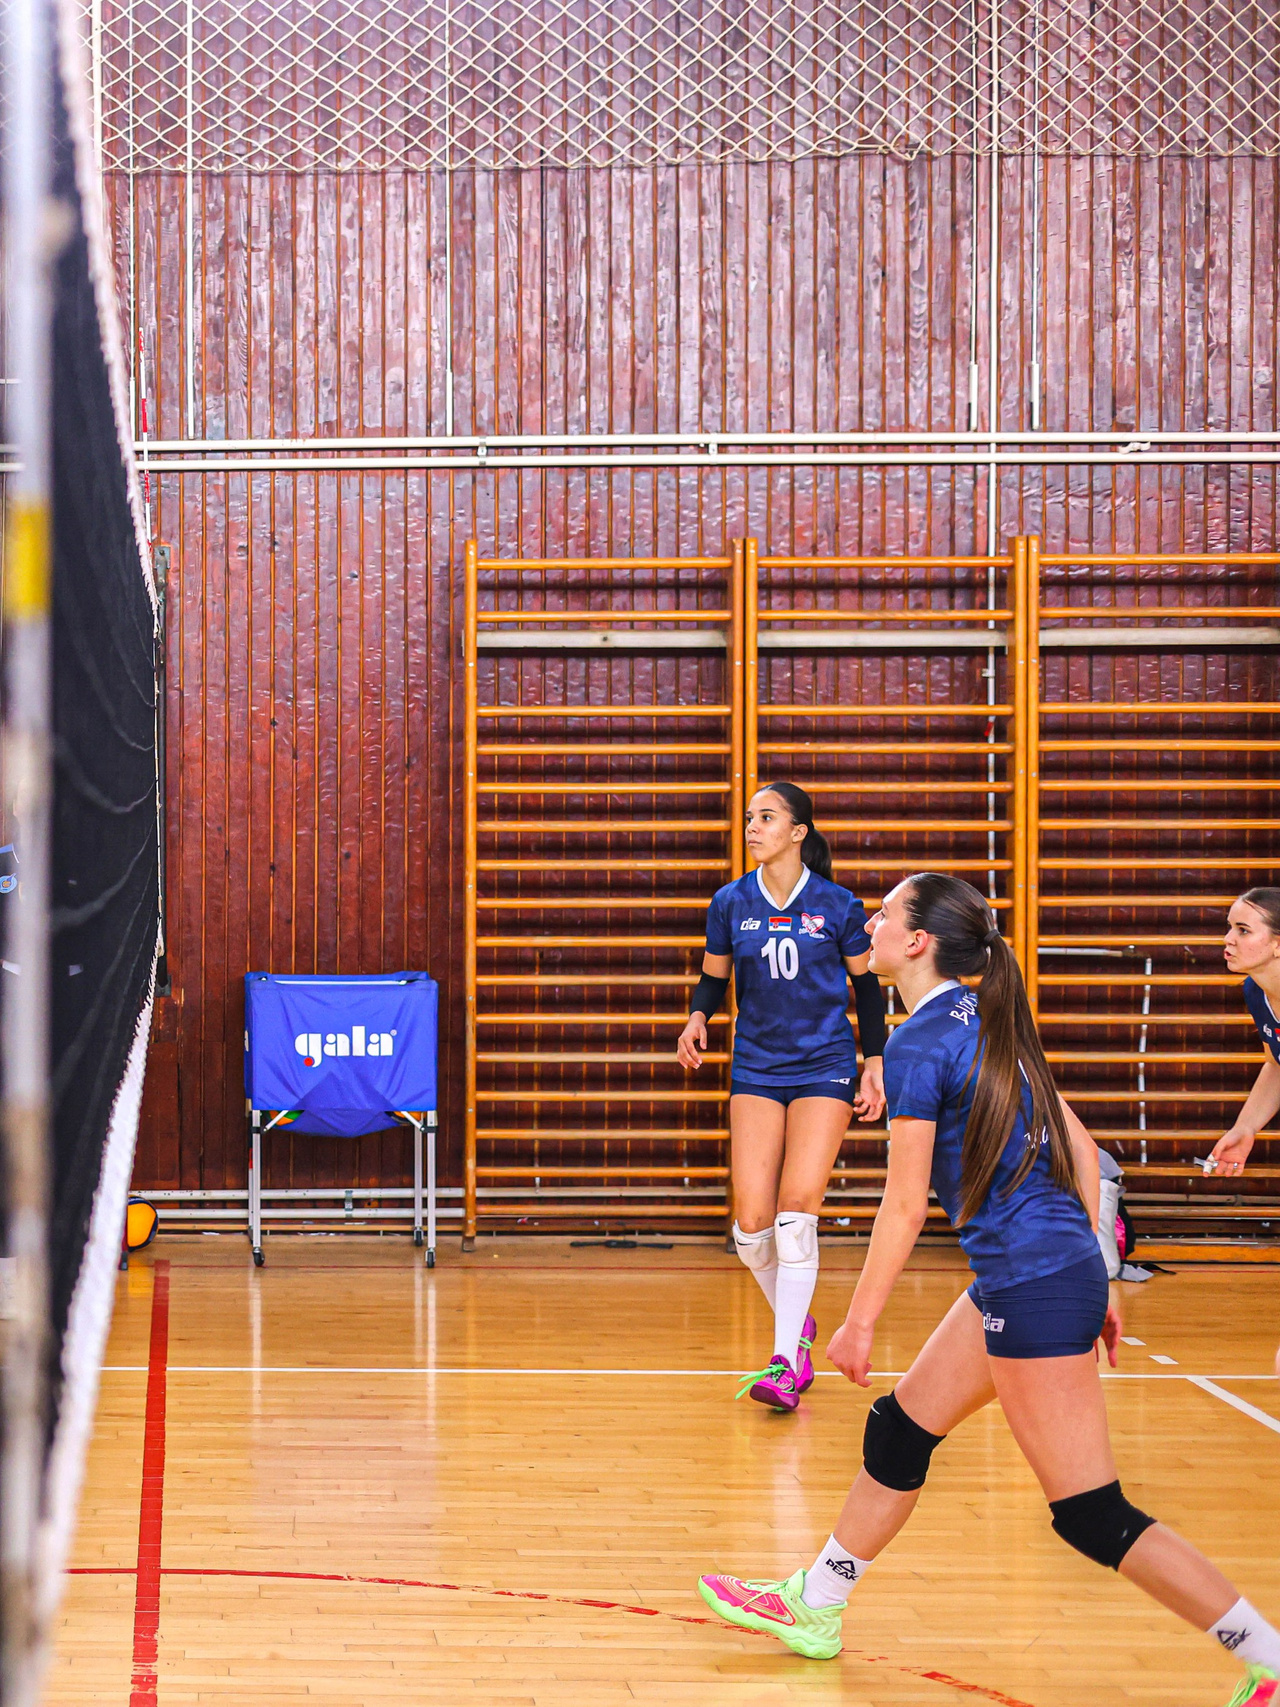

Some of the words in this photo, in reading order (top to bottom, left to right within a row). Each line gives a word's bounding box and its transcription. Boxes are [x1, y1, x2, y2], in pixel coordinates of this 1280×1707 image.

[761, 937, 800, 981] 10
[295, 1025, 394, 1068] gala
[825, 1558, 860, 1582] PEAK
